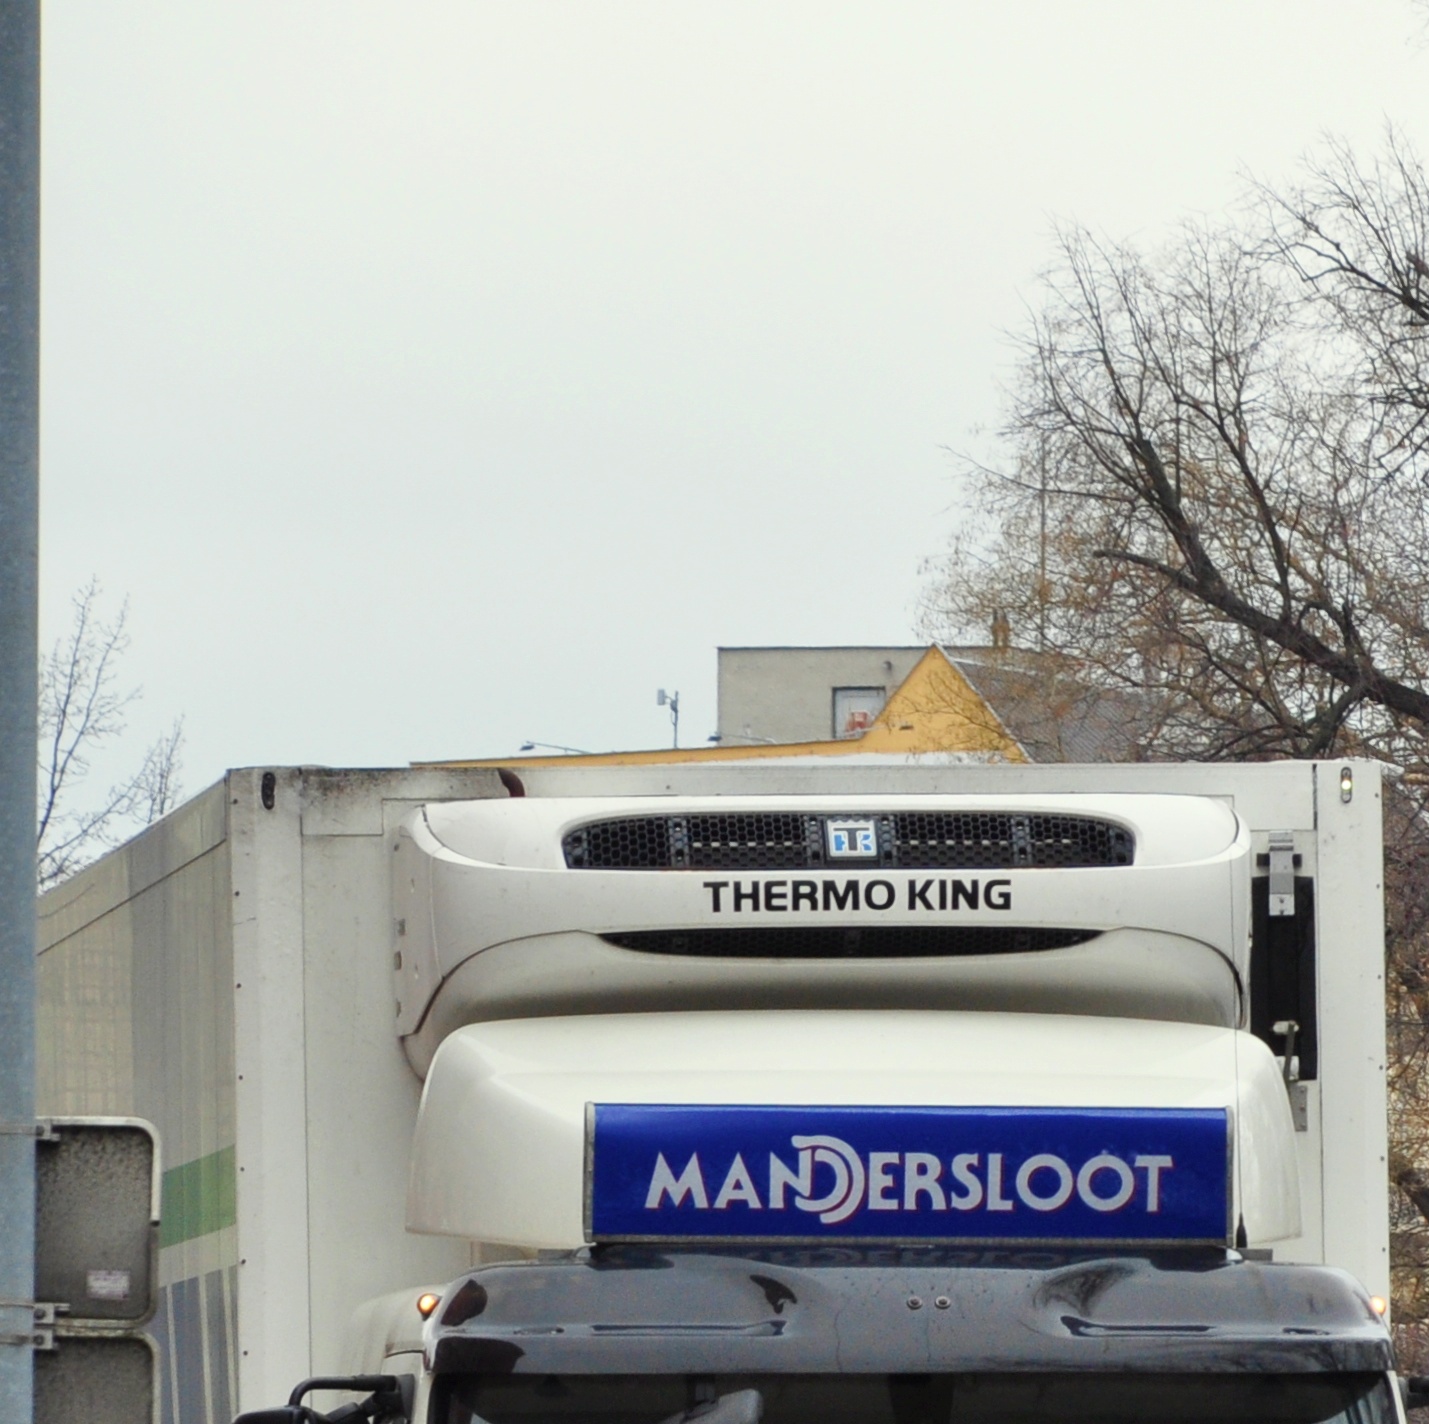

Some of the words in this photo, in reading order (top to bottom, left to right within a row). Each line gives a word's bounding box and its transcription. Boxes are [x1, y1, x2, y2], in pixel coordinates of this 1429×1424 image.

[703, 878, 896, 913] THERMO
[907, 878, 1013, 911] KING
[644, 1135, 1174, 1224] MANDERSLOOT
